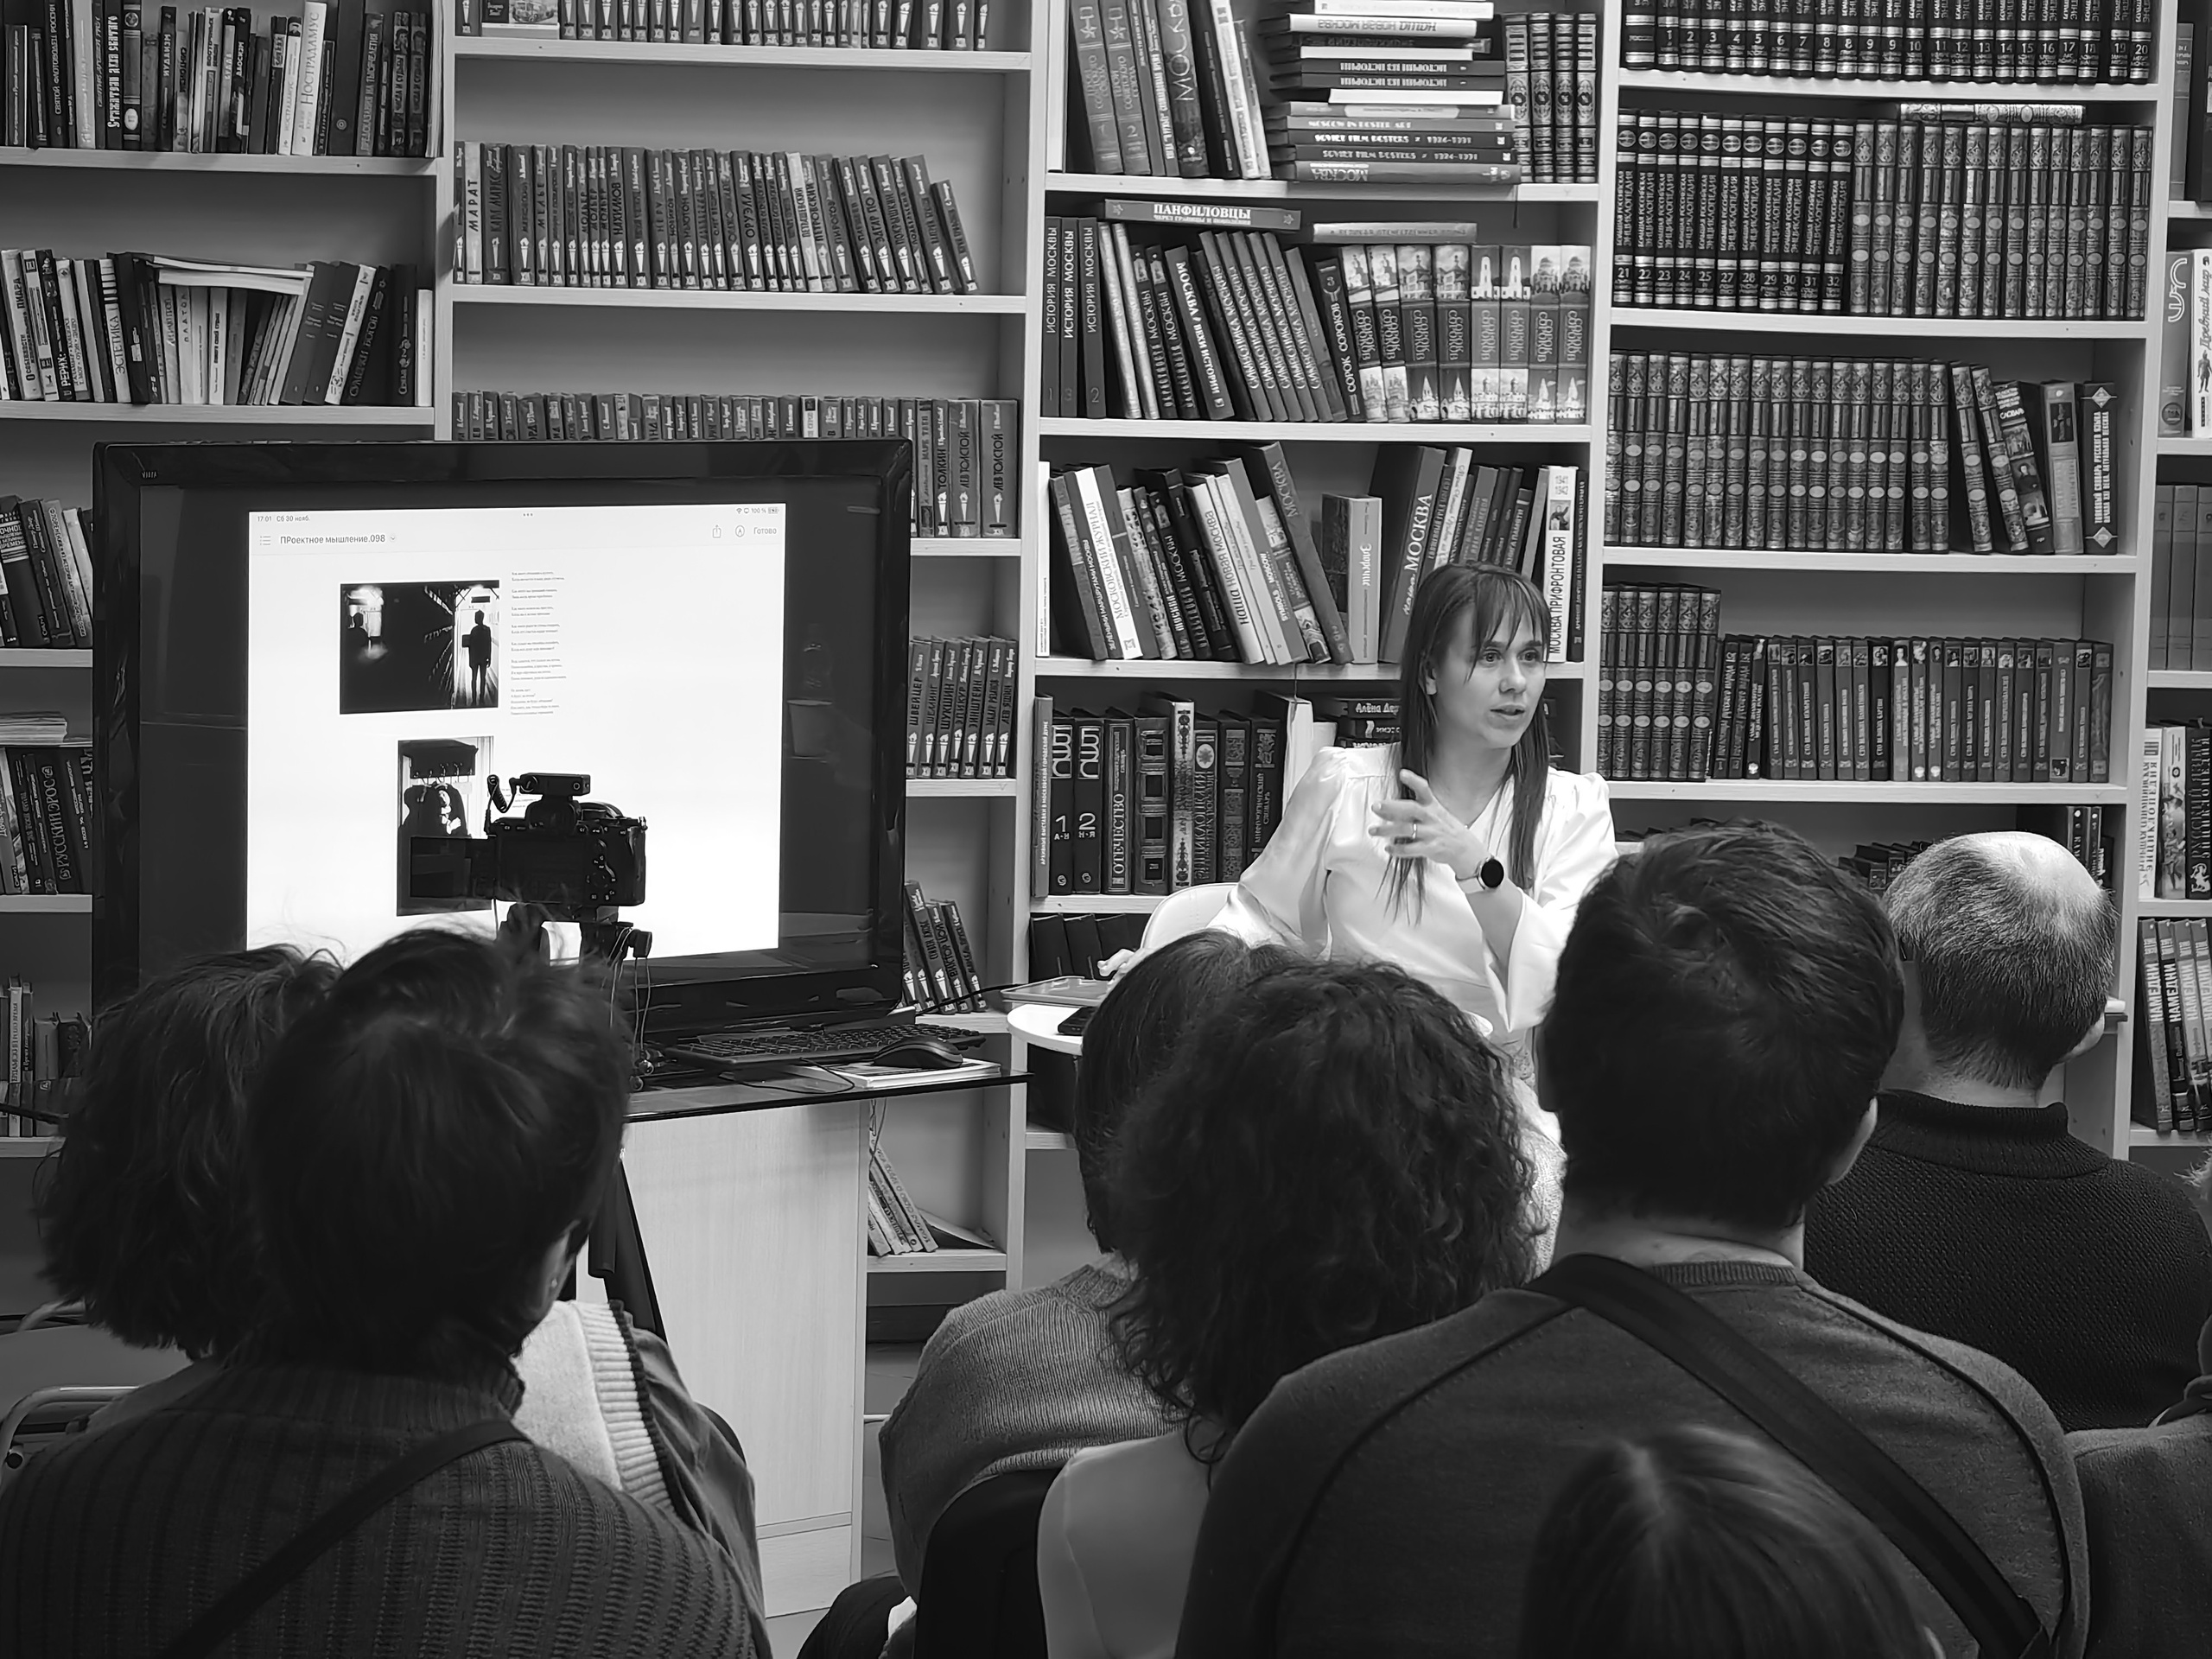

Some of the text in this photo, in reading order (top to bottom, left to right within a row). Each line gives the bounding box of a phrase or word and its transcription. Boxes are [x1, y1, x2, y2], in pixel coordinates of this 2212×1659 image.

[1165, 0, 1195, 101] МОСКВ
[1666, 29, 1673, 41] 1
[1686, 31, 1694, 41] 2
[1709, 31, 1717, 42] 3
[1732, 33, 1740, 43] 4
[1754, 33, 1762, 44] 5
[1777, 34, 1784, 45] 6
[1799, 35, 1807, 47] 7
[1822, 36, 1830, 48] 8
[1845, 36, 1852, 48] 8
[1866, 38, 1874, 49] 9
[1889, 39, 1896, 50] 9
[1910, 40, 1921, 51] 10
[1956, 41, 1968, 52] 12
[1979, 41, 1991, 53] 13
[2000, 41, 2012, 53] 14
[2021, 41, 2033, 53] 15
[2043, 41, 2055, 53] 16
[2063, 41, 2075, 52] 17
[2135, 43, 2148, 54] 20
[162, 34, 171, 76] ИУДАИЗМ
[236, 41, 245, 77] ДАОСИЗМ
[1340, 62, 1447, 72] ИСТОРИИ ИЗ ИСТОРИИ
[360, 33, 378, 150] ПРЕДСКАЗАНИЯ НА ТЫСЯЧЕЛЕТИЯ
[1340, 77, 1447, 86] ИСТОРИИ ИЗ ИСТОРИИ
[1126, 124, 1139, 137] 2
[1310, 168, 1369, 181] МОСКВА
[467, 179, 479, 232] МАРАТ
[612, 182, 623, 235] НАХИМОВ
[742, 194, 755, 238] ОРУЭЛЛ
[794, 188, 810, 238] ПЕТРАШЕВСКИЙ
[805, 182, 823, 241] ПЕТРОВСКИЙ
[827, 200, 842, 245] ПИРОГОВ
[866, 197, 885, 244] ЭДГАР ПО
[885, 193, 905, 245] ПОКРЫШКИН
[1154, 204, 1251, 219] ПАНФИЛОВЦЫ
[1046, 227, 1058, 334] ИСТОРИЯ МОСКВЫ
[1064, 231, 1074, 338] ИСТОРИЯ МОСКВЫ
[1083, 227, 1096, 333] ИСТОРИЯ МОСКВЫ
[1618, 267, 1629, 277] 21
[1638, 269, 1651, 279] 22
[1658, 270, 1671, 280] 23
[1678, 270, 1691, 280] 24
[1699, 270, 1711, 281] 25
[1720, 272, 1733, 282] 27
[1743, 272, 1756, 283] 28
[1764, 275, 1777, 284] 29
[1783, 275, 1796, 285] 30
[1804, 276, 1815, 287] 31
[1827, 276, 1840, 286] 32
[1141, 289, 1159, 340] МОСКВЫ
[1158, 291, 1178, 340] МОСКВЫ
[1175, 262, 1220, 394] МОСКВА ВЕХИ ИСТОРИИ
[109, 315, 125, 375] ЭСТЕТИКА
[1230, 318, 1260, 389] СИМВОЛИКА
[1245, 318, 1276, 389] СИМВОЛИКА
[1261, 318, 1291, 389] СИМВОЛИКА
[1276, 318, 1306, 389] СИМВОЛИКА
[1292, 318, 1321, 389] СИМВОЛИКА
[1331, 302, 1357, 393] СОРОК СОРОКОВ
[56, 352, 71, 387] РЕРИХ:
[348, 350, 369, 397] СУМЕРКИ
[1090, 387, 1100, 403] 2
[937, 448, 947, 489] ТОЛКИН
[957, 431, 970, 488] ЛЕВ ТОЛСТОЙ
[991, 434, 1004, 491] ЛЕВ ТОЛСТОЙ
[2094, 464, 2102, 491] СЛОВАРЬ
[1271, 461, 1299, 517] МОСКВА
[1086, 501, 1109, 547] ЖУРНАЛ
[2093, 493, 2102, 524] ТОЛКОВЫЙ
[2102, 501, 2111, 524] НАЧАЛА
[280, 534, 386, 544] ПРоектное мышление.098
[1403, 493, 1433, 573] МОСКВА
[1506, 508, 1524, 566] КНИГА ПАМЯТИ
[1165, 535, 1186, 582] МОСКВЫ
[1094, 548, 1124, 620] МОСКОВСКИЙ
[1260, 552, 1288, 622] SYMBOLS MOSCOW
[1548, 537, 1567, 655] МОСКВА ПРИФРОНТОВАЯ
[908, 676, 923, 726] ШВЕЙЦЕР
[925, 683, 938, 724] ШЕЛЛИНГ
[940, 683, 955, 730] ШУКШИН
[955, 686, 966, 724] ЭПИКУР
[968, 680, 982, 728] ЭЙНШТЕЙН
[1001, 684, 1012, 724] ЛЕВ ЯШИН
[1355, 702, 1382, 713] Алёна
[43, 779, 70, 868] РУССКИЙ ЭРОС
[1056, 815, 1066, 832] 1
[1078, 812, 1096, 830] 2
[1262, 791, 1271, 825] СЛОВАРЬ
[1112, 794, 1125, 874] ОТЕЧЕСТВО
[943, 944, 958, 977] ВИКТОР
[2145, 962, 2164, 1022] НАМЕДНИ
[2164, 963, 2182, 1022] НАМЕДНИ
[2181, 964, 2199, 1020] НАМЕДНИ
[2197, 963, 2212, 1020] НАМЕДНИ
